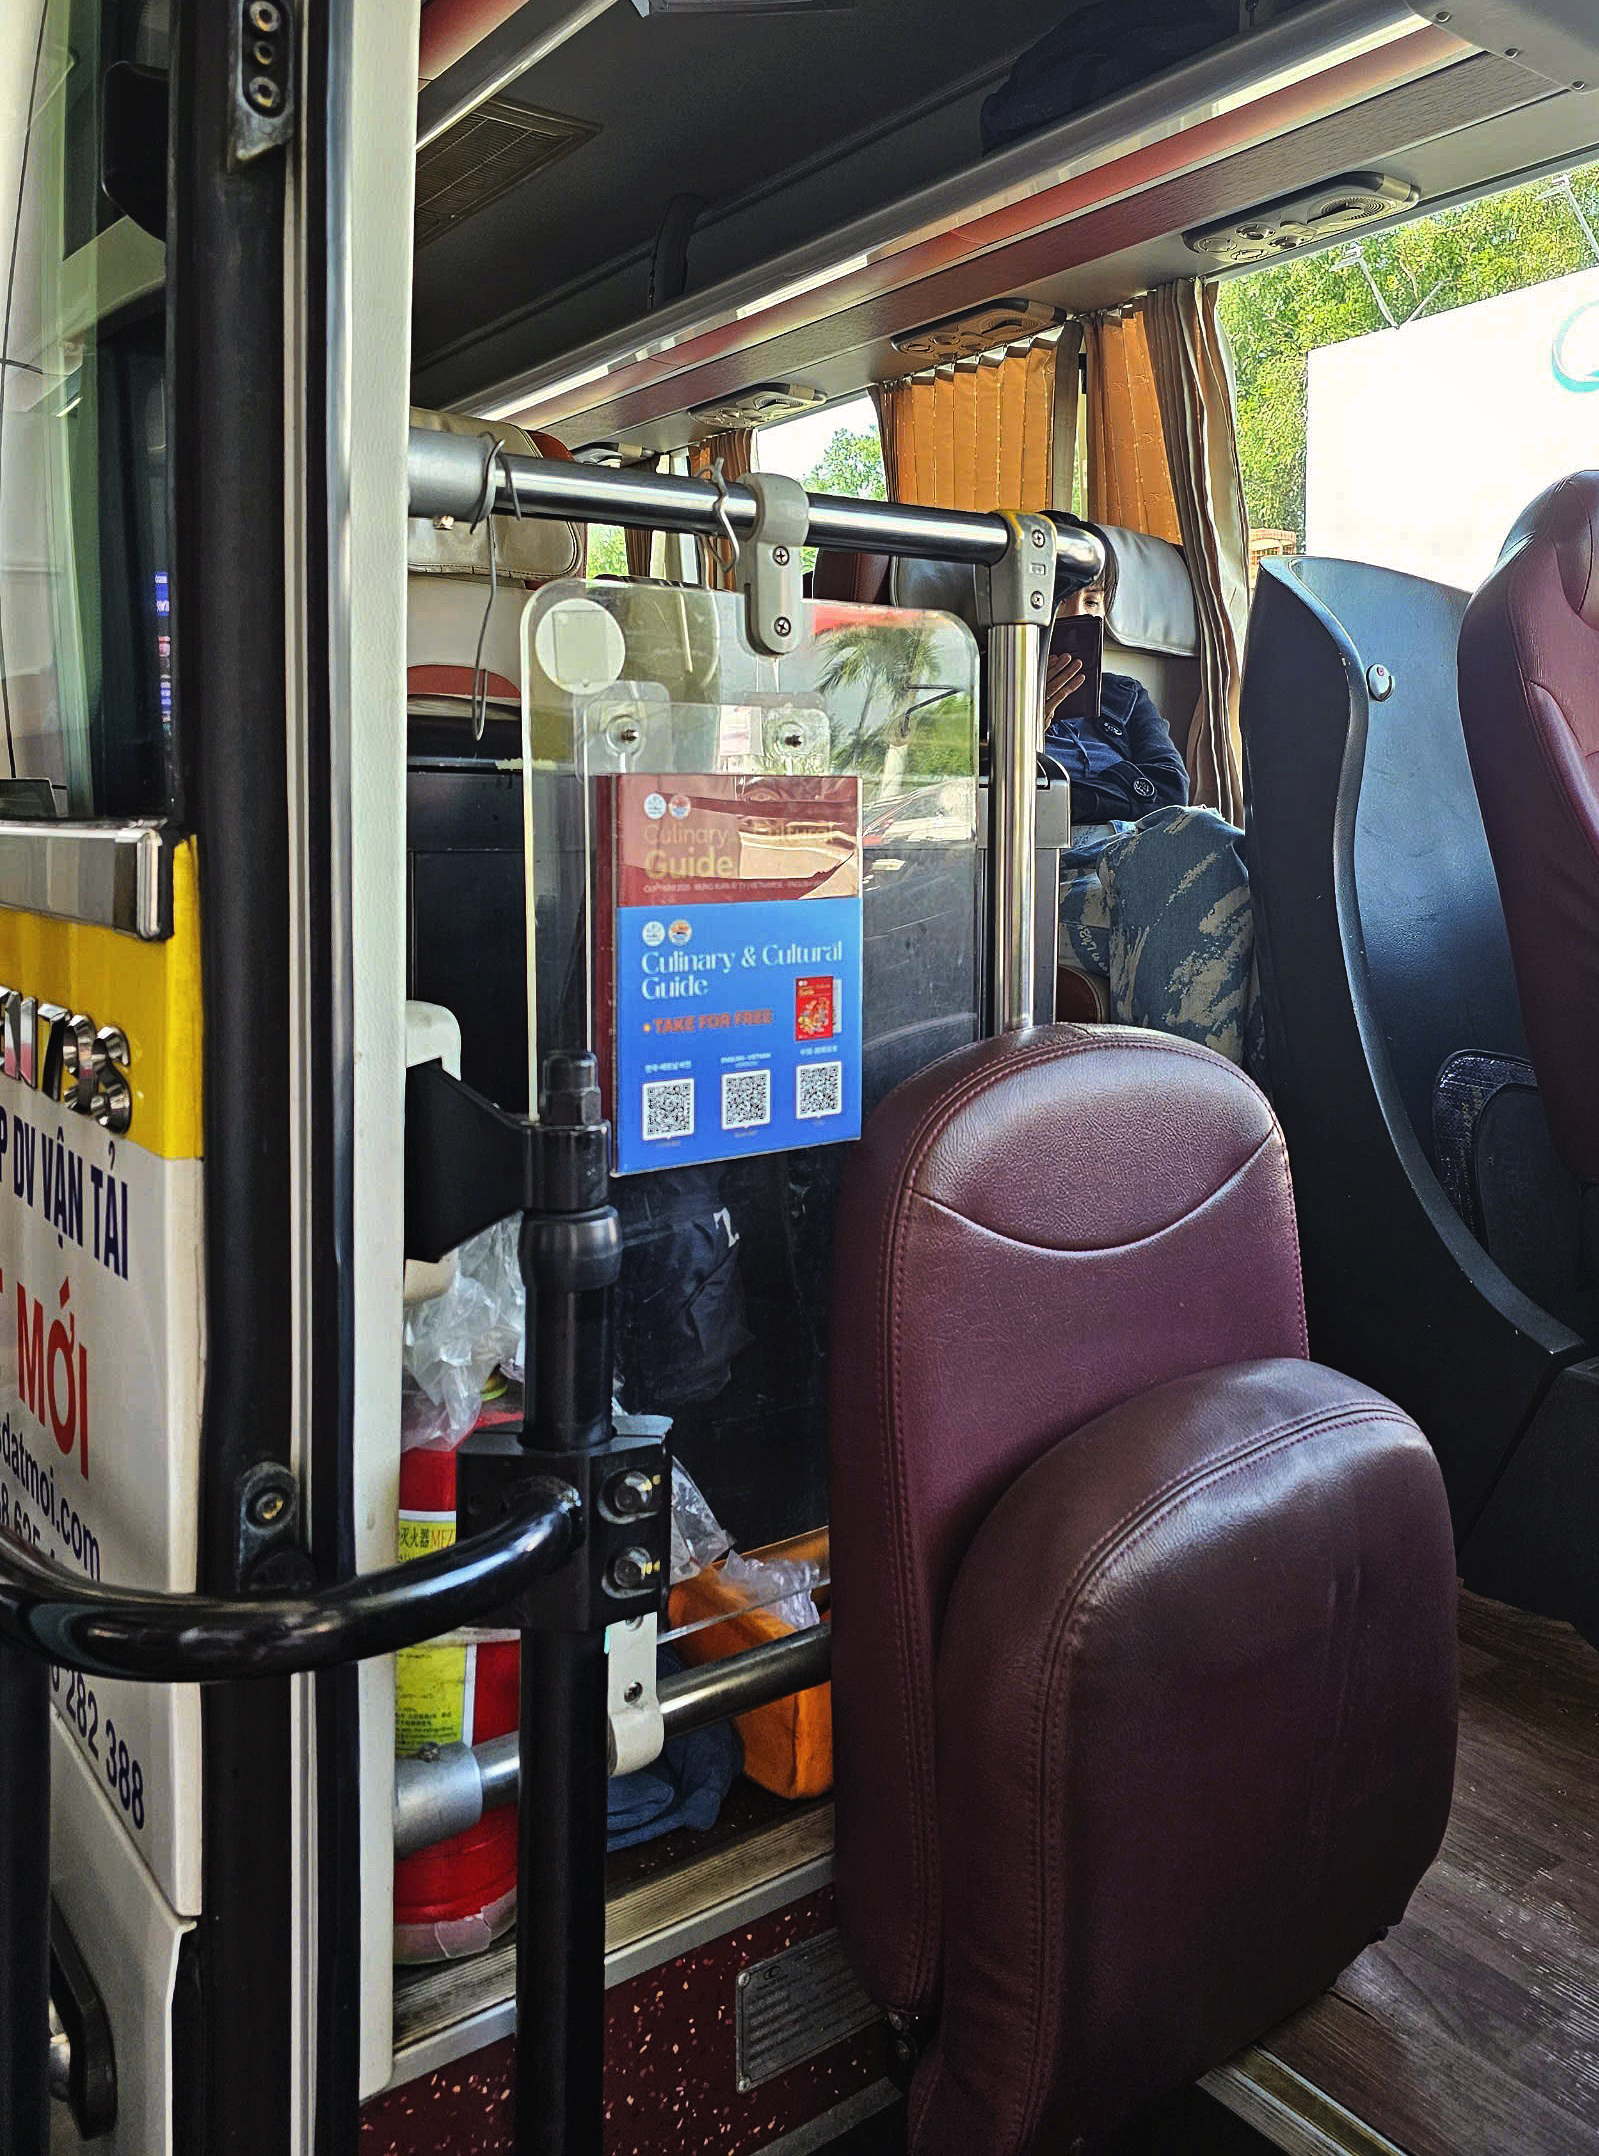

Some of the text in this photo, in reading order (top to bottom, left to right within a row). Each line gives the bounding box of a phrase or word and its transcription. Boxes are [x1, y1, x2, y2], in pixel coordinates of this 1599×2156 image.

[643, 823, 728, 850] Culinary
[644, 846, 733, 880] Guide
[641, 940, 842, 973] Culinary & Cultural
[641, 975, 708, 1000] Guide
[654, 1008, 773, 1034] TAKE FOR FREE
[13, 1115, 36, 1208] DV
[41, 1126, 84, 1249] VẬN
[90, 1140, 128, 1280] TẢI
[16, 1275, 89, 1482] MỚI
[0, 1412, 100, 1582] datmoi.com
[105, 1719, 144, 1830] 388
